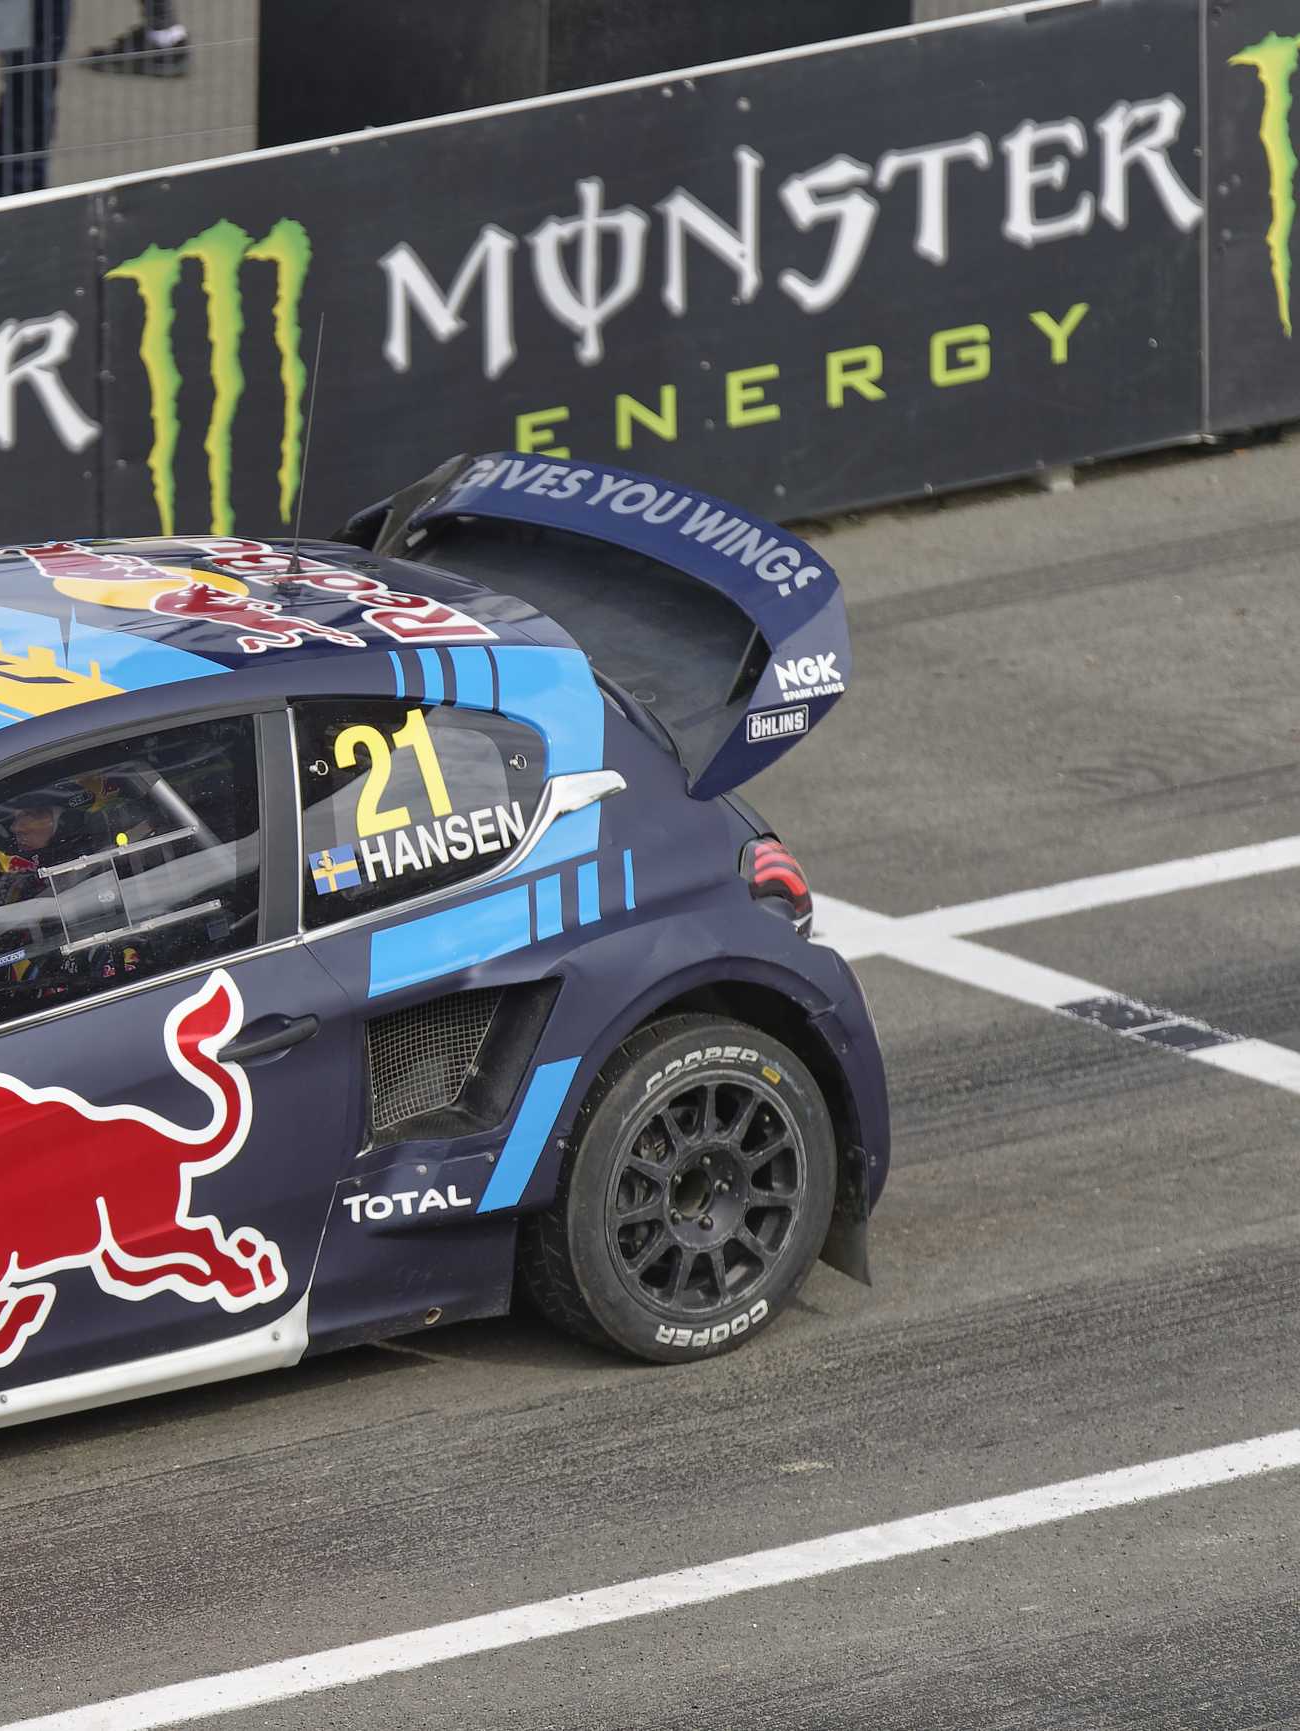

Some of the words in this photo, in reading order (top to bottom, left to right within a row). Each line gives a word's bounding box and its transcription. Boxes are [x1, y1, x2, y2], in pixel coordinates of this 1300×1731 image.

[379, 93, 1203, 378] MONSTER
[516, 302, 1089, 458] ENERGY
[451, 458, 595, 500] GIVES
[586, 474, 693, 526] YOU
[679, 502, 824, 598] WINGS
[773, 651, 842, 691] NGK
[783, 689, 814, 703] SPARK
[814, 682, 846, 698] PLUGS
[751, 710, 807, 739] ÖHLINS
[333, 708, 453, 838] 21
[359, 801, 527, 883] HANSEN
[342, 1184, 472, 1223] TOTAL
[655, 1298, 769, 1348] COOPER
